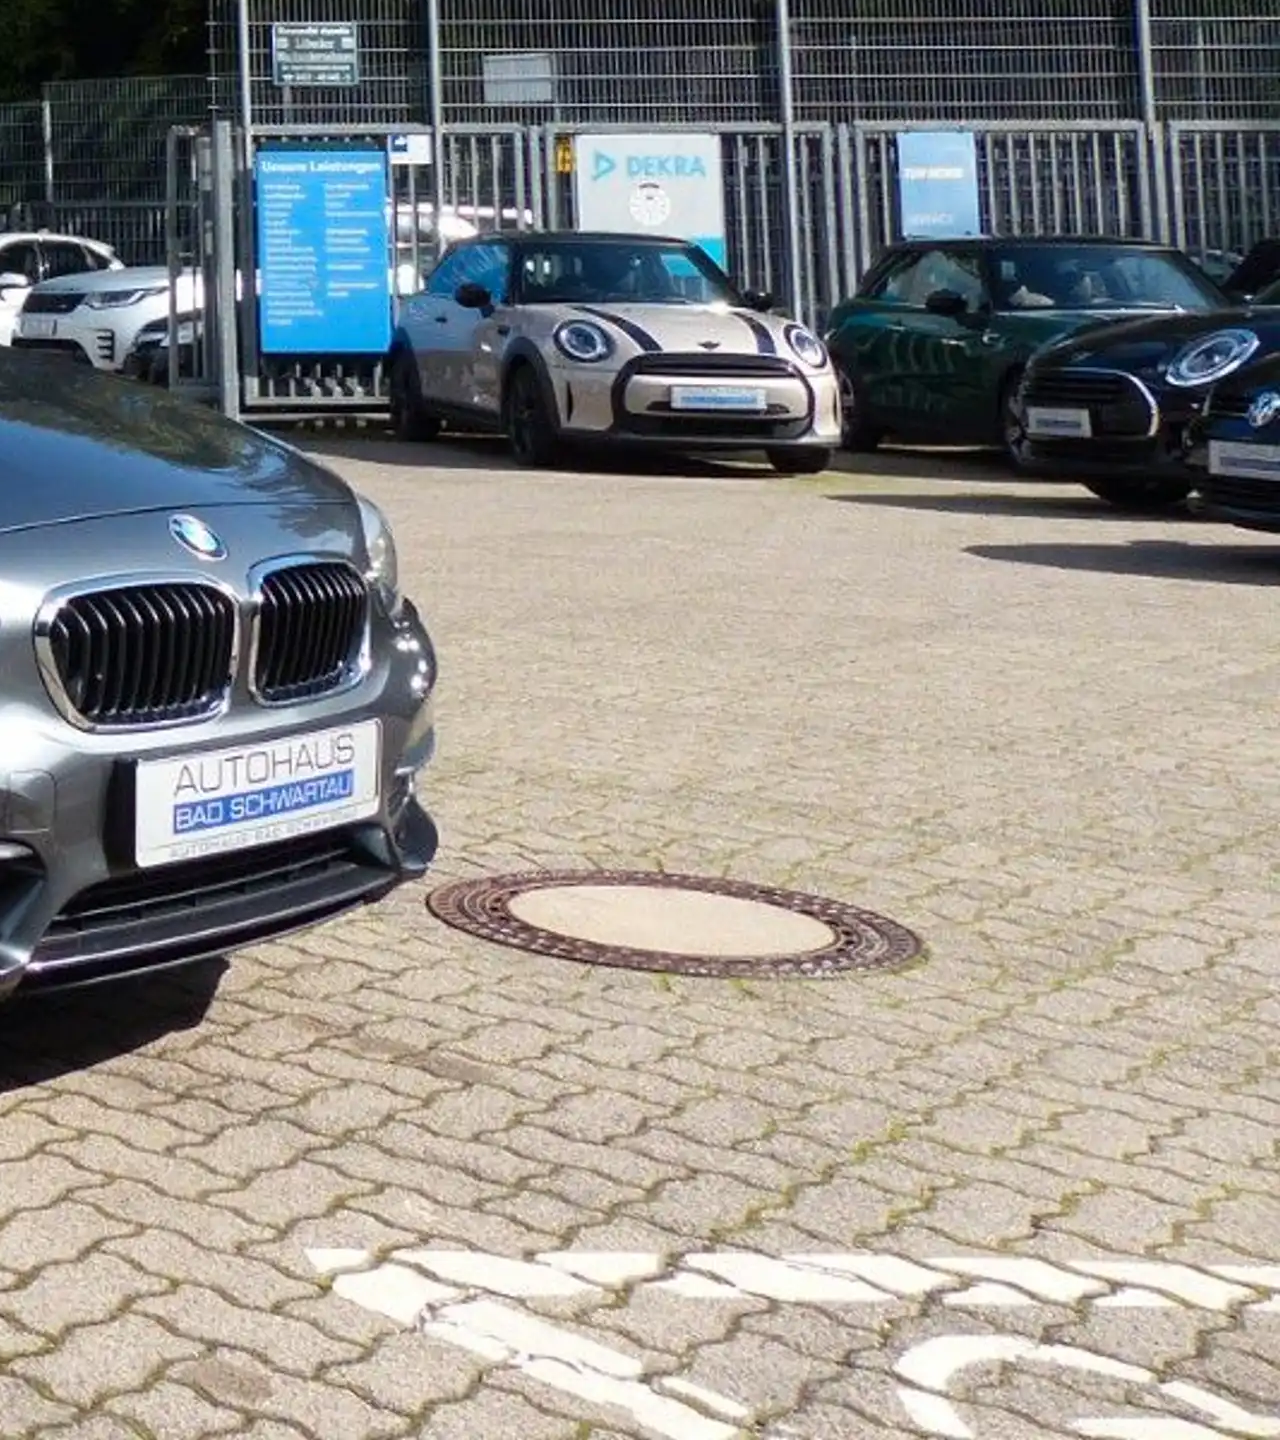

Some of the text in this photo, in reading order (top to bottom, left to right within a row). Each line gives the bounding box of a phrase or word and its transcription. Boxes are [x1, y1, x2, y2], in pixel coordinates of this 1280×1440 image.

[626, 154, 707, 178] DEKRA
[173, 732, 356, 797] AUTOHAUS
[175, 772, 353, 831] BAD SCHWARTAU
